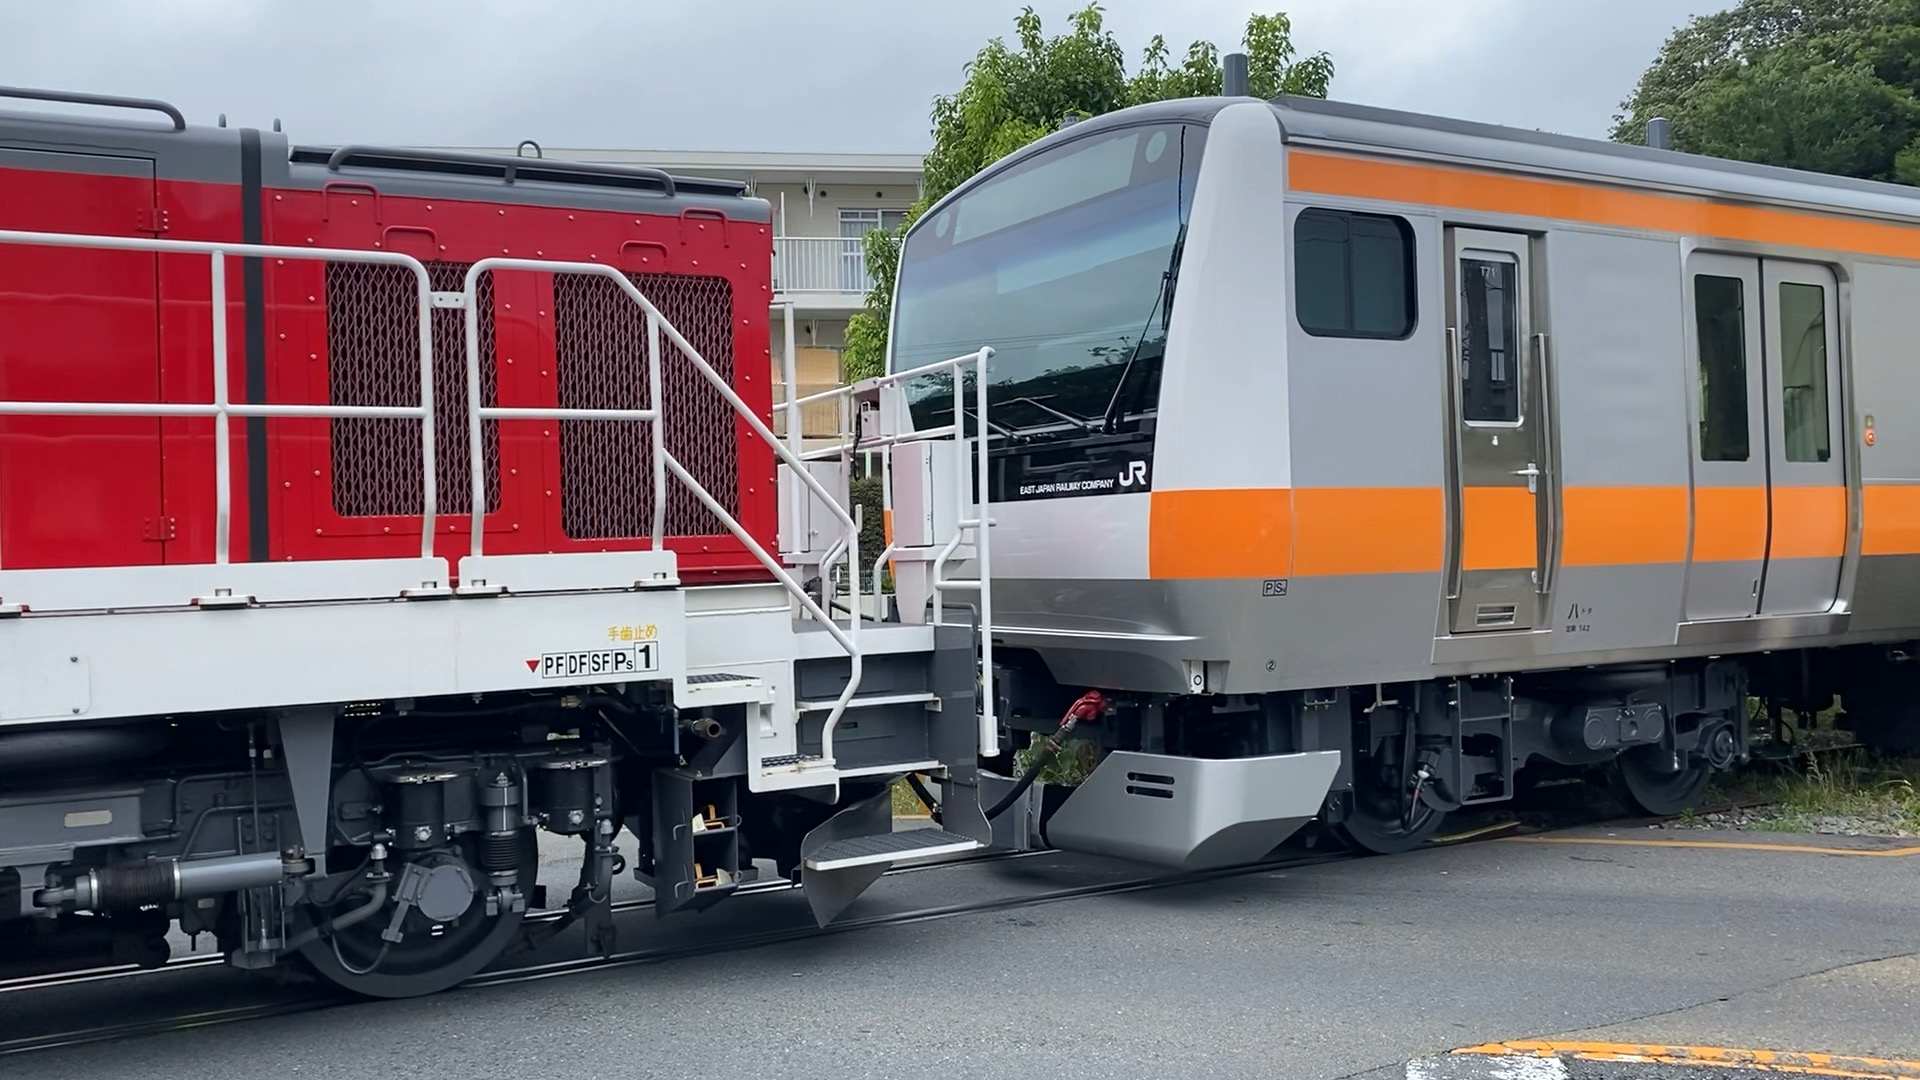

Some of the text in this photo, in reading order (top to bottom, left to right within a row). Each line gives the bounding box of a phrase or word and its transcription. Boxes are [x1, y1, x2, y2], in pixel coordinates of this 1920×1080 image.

[1118, 460, 1147, 487] JR
[1020, 479, 1115, 495] EAST JAPAN RAILWAY COMPANY
[607, 624, 658, 641] 手歯止め
